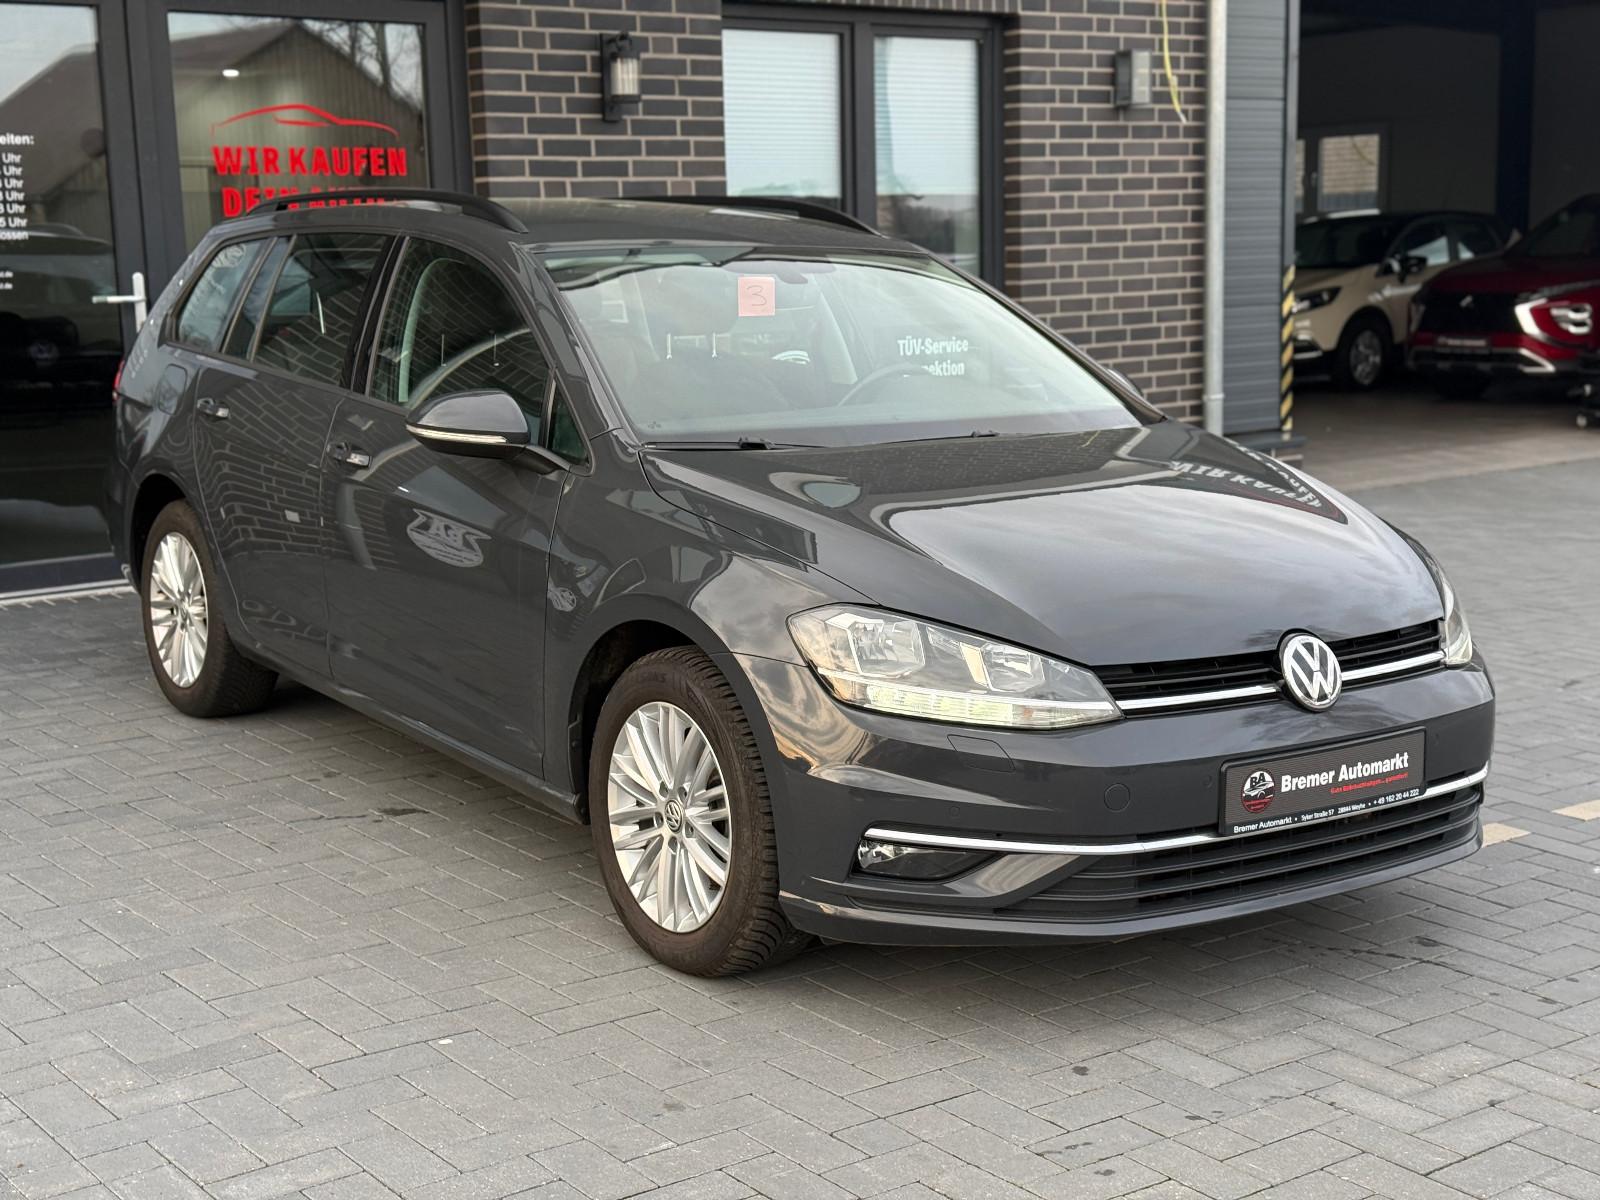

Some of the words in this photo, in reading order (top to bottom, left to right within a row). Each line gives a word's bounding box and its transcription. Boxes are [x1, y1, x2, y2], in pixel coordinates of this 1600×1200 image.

[2, 152, 22, 164] Uhr
[211, 146, 280, 176] WIR
[288, 146, 408, 177] KAUFEN
[3, 165, 23, 176] Uhr
[4, 177, 24, 188] Uhr
[5, 190, 25, 201] Uhr
[6, 203, 26, 214] Uhr
[8, 216, 28, 228] Uhr
[746, 284, 767, 307] 3
[897, 335, 969, 356] TÜV-Service
[1281, 769, 1335, 793] Bremer
[1338, 751, 1409, 782] Automarkt
[1233, 823, 1258, 834] Bremer
[1258, 816, 1293, 829] Automarkt
